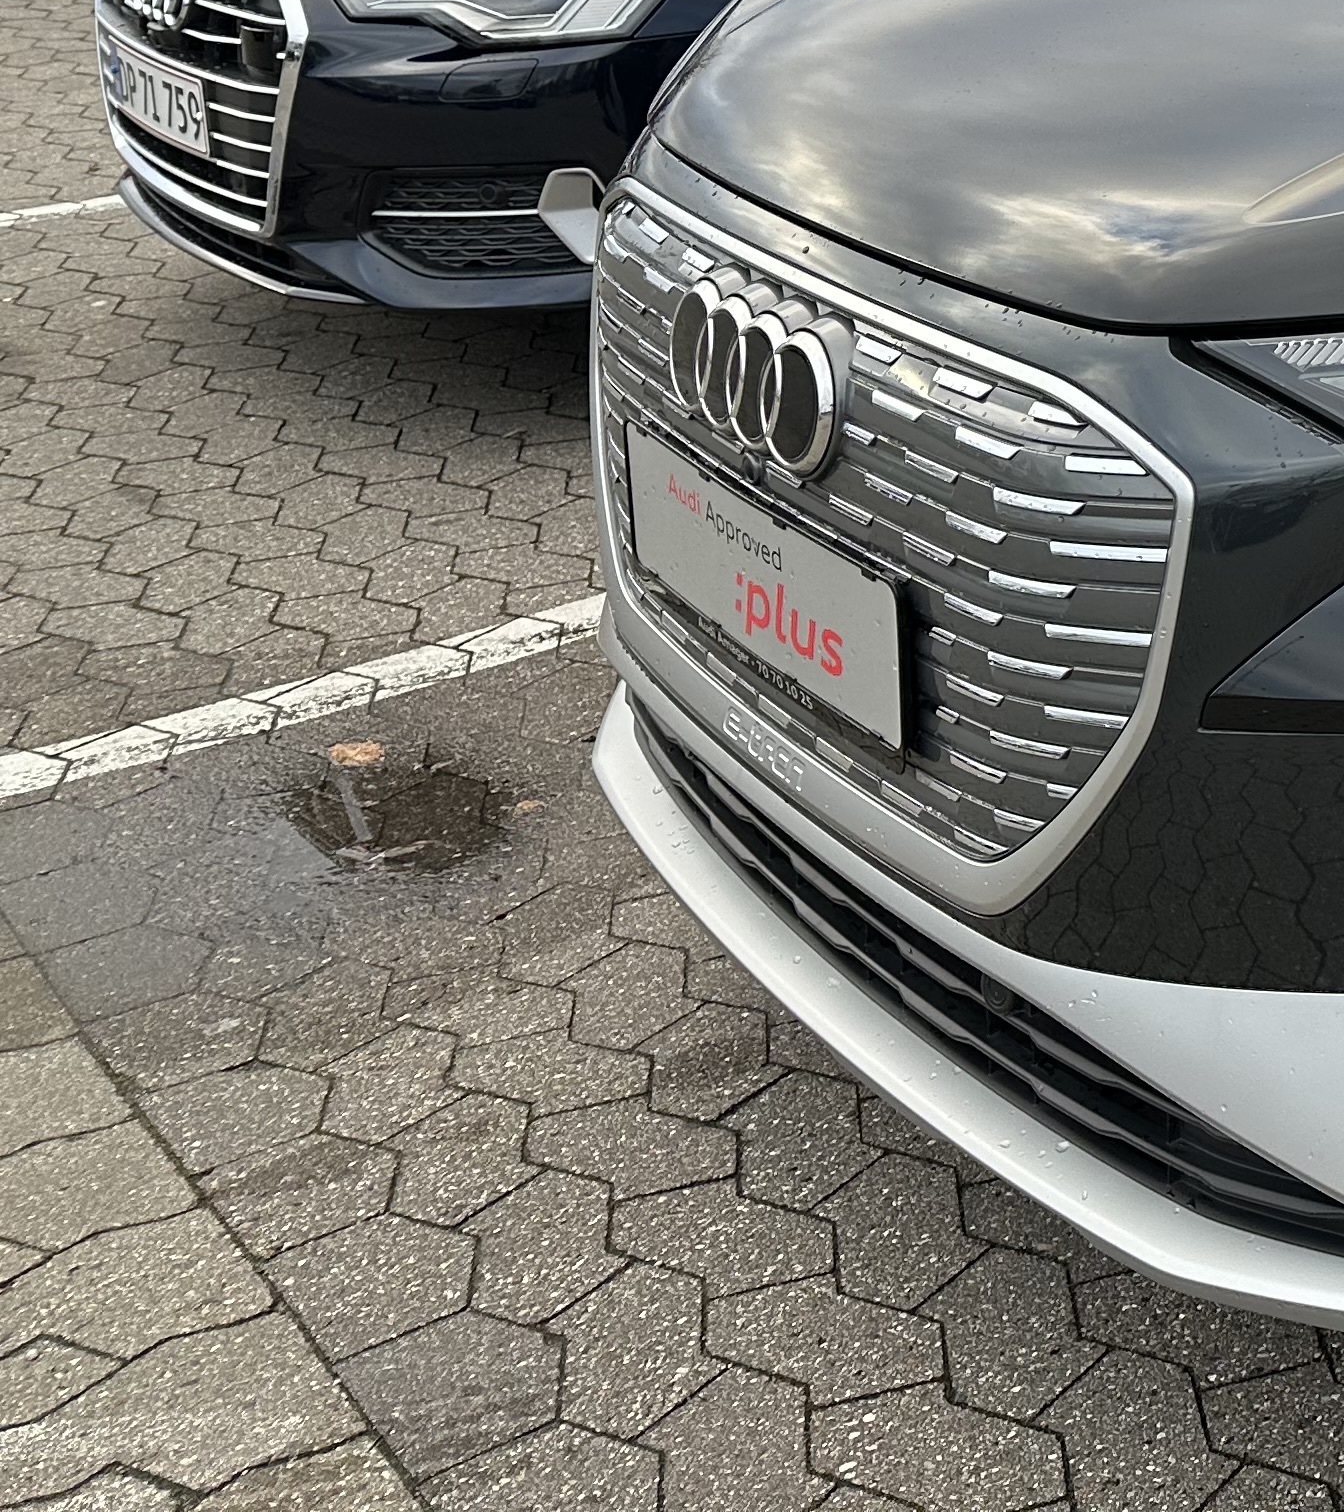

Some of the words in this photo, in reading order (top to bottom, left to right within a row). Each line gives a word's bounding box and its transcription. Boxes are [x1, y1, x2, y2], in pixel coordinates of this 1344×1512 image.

[117, 56, 136, 107] DP
[138, 69, 160, 123] 71
[162, 81, 203, 140] 759
[667, 473, 701, 516] Audi
[705, 500, 783, 572] Approved
[756, 660, 769, 679] 70
[771, 671, 784, 689] 70
[785, 681, 798, 700] 10
[800, 692, 814, 710] 25
